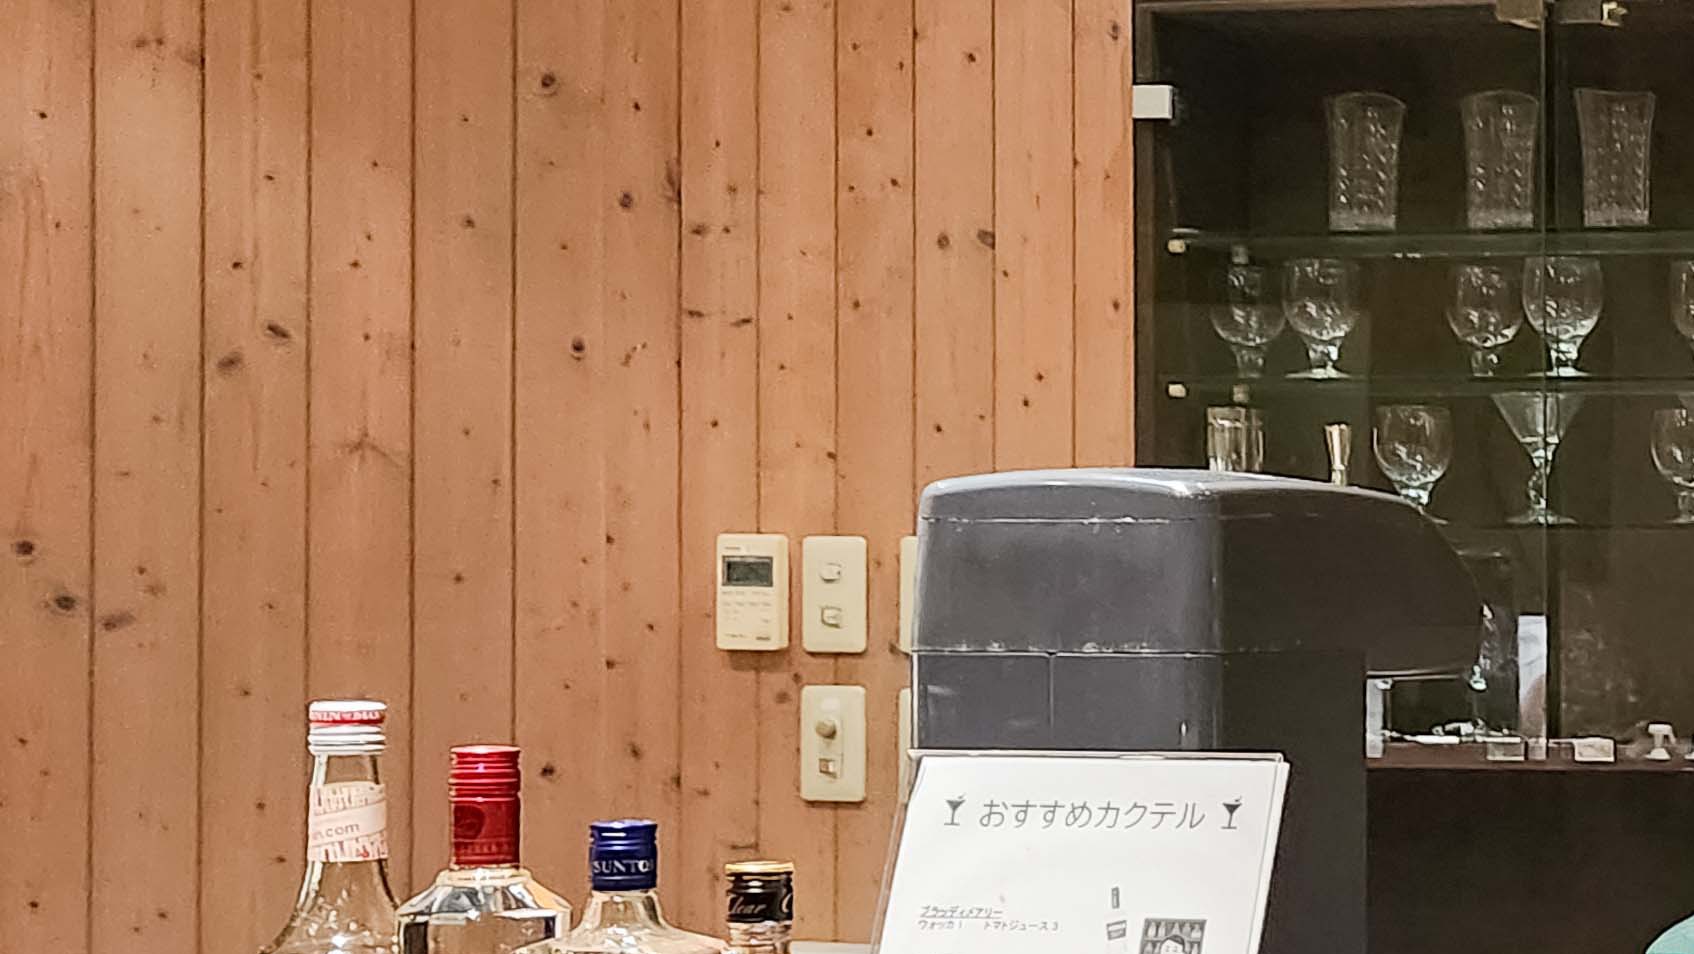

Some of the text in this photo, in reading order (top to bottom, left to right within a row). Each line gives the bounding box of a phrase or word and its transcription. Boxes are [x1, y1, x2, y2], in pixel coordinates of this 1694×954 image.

[979, 799, 1207, 829] おすすめカクテル
